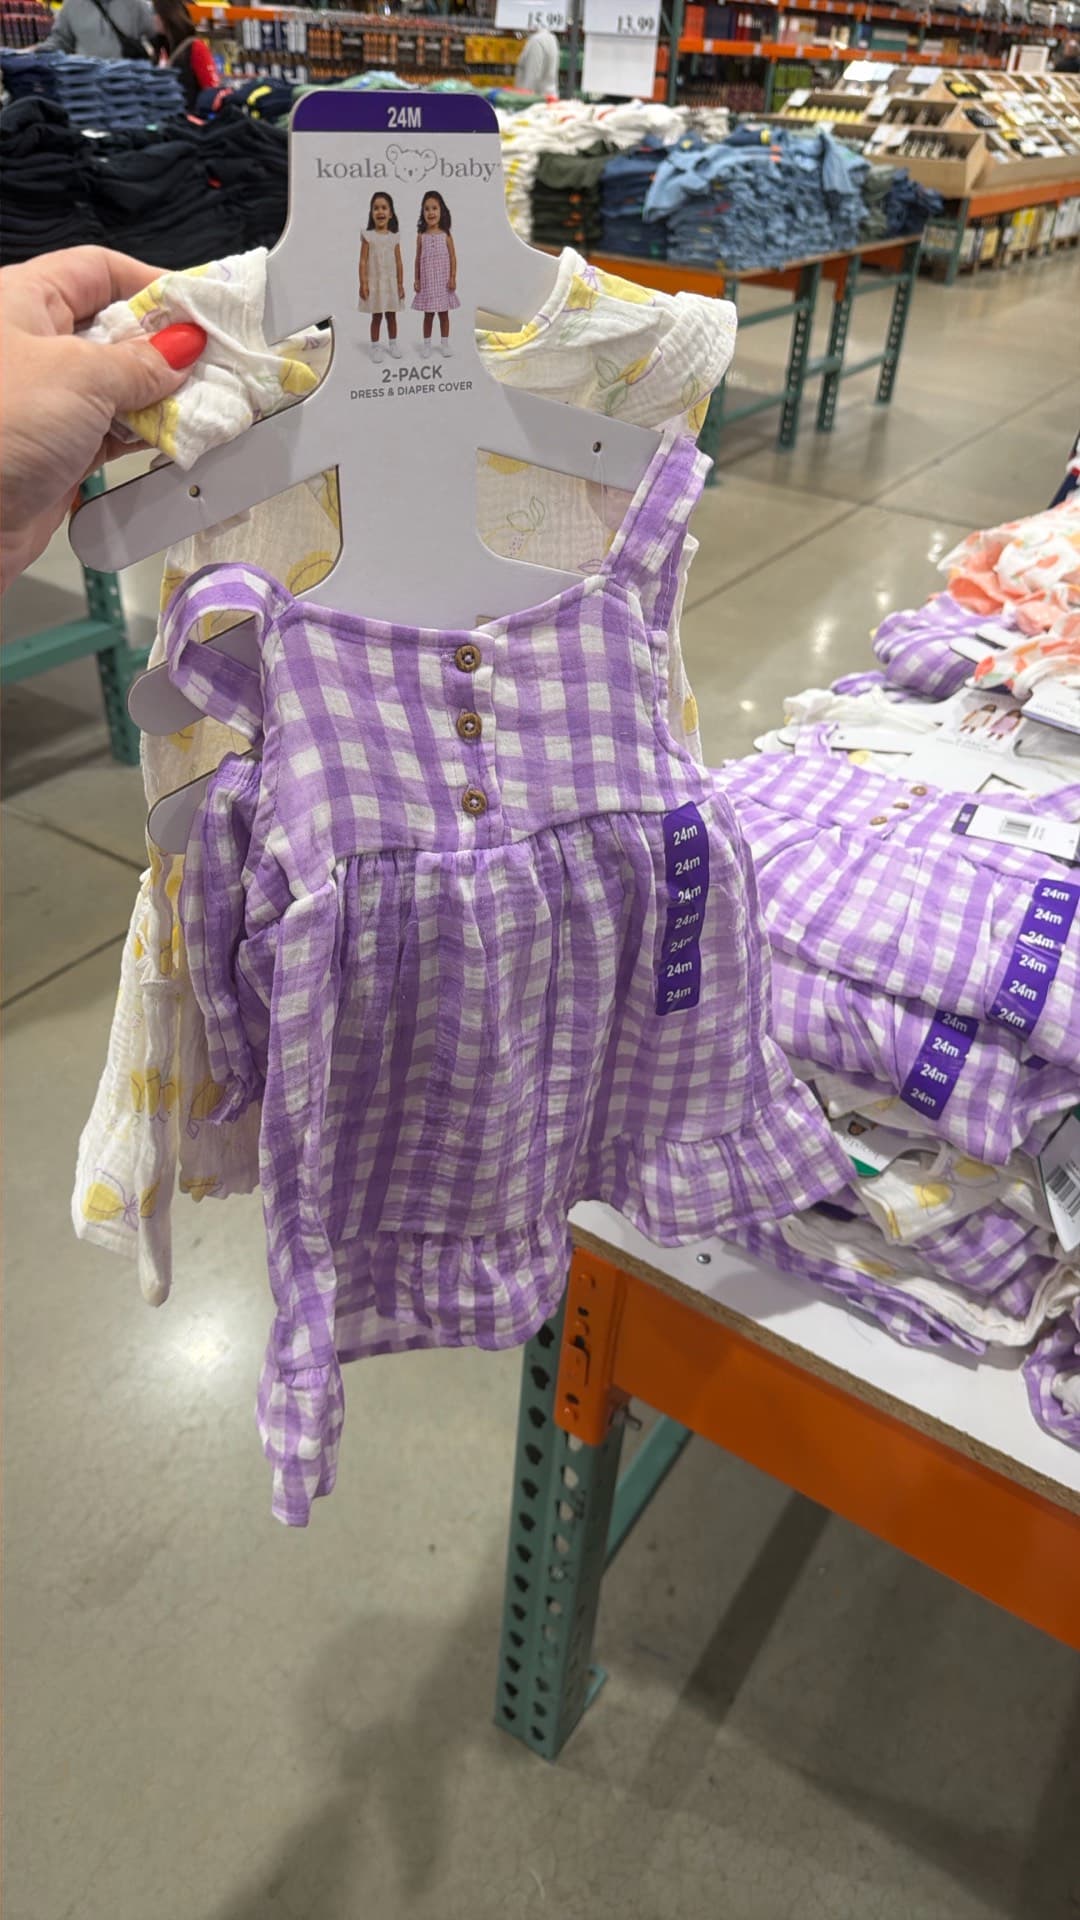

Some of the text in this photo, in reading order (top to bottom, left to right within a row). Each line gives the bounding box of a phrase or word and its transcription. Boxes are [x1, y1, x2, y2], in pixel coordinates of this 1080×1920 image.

[387, 107, 422, 128] 24M
[315, 157, 497, 182] koala baby
[381, 365, 443, 383] 2-PACK
[350, 381, 473, 400] DRESS & DIAPER COVER
[673, 824, 698, 846] 24m
[675, 855, 701, 876] 24m
[678, 885, 701, 904] 24m
[1041, 887, 1070, 901] 24m
[675, 913, 700, 929] 24m
[1034, 908, 1062, 925] 24m
[1027, 931, 1054, 949] 24m
[667, 962, 693, 977] 24m
[1019, 954, 1047, 974] 24m
[666, 987, 692, 1003] 24m
[1009, 980, 1037, 1001] 24m
[942, 1013, 968, 1033] 24m
[999, 1008, 1026, 1029] 24m
[932, 1037, 960, 1058] 24m
[920, 1063, 948, 1085] 24m
[910, 1088, 936, 1107] 24m
